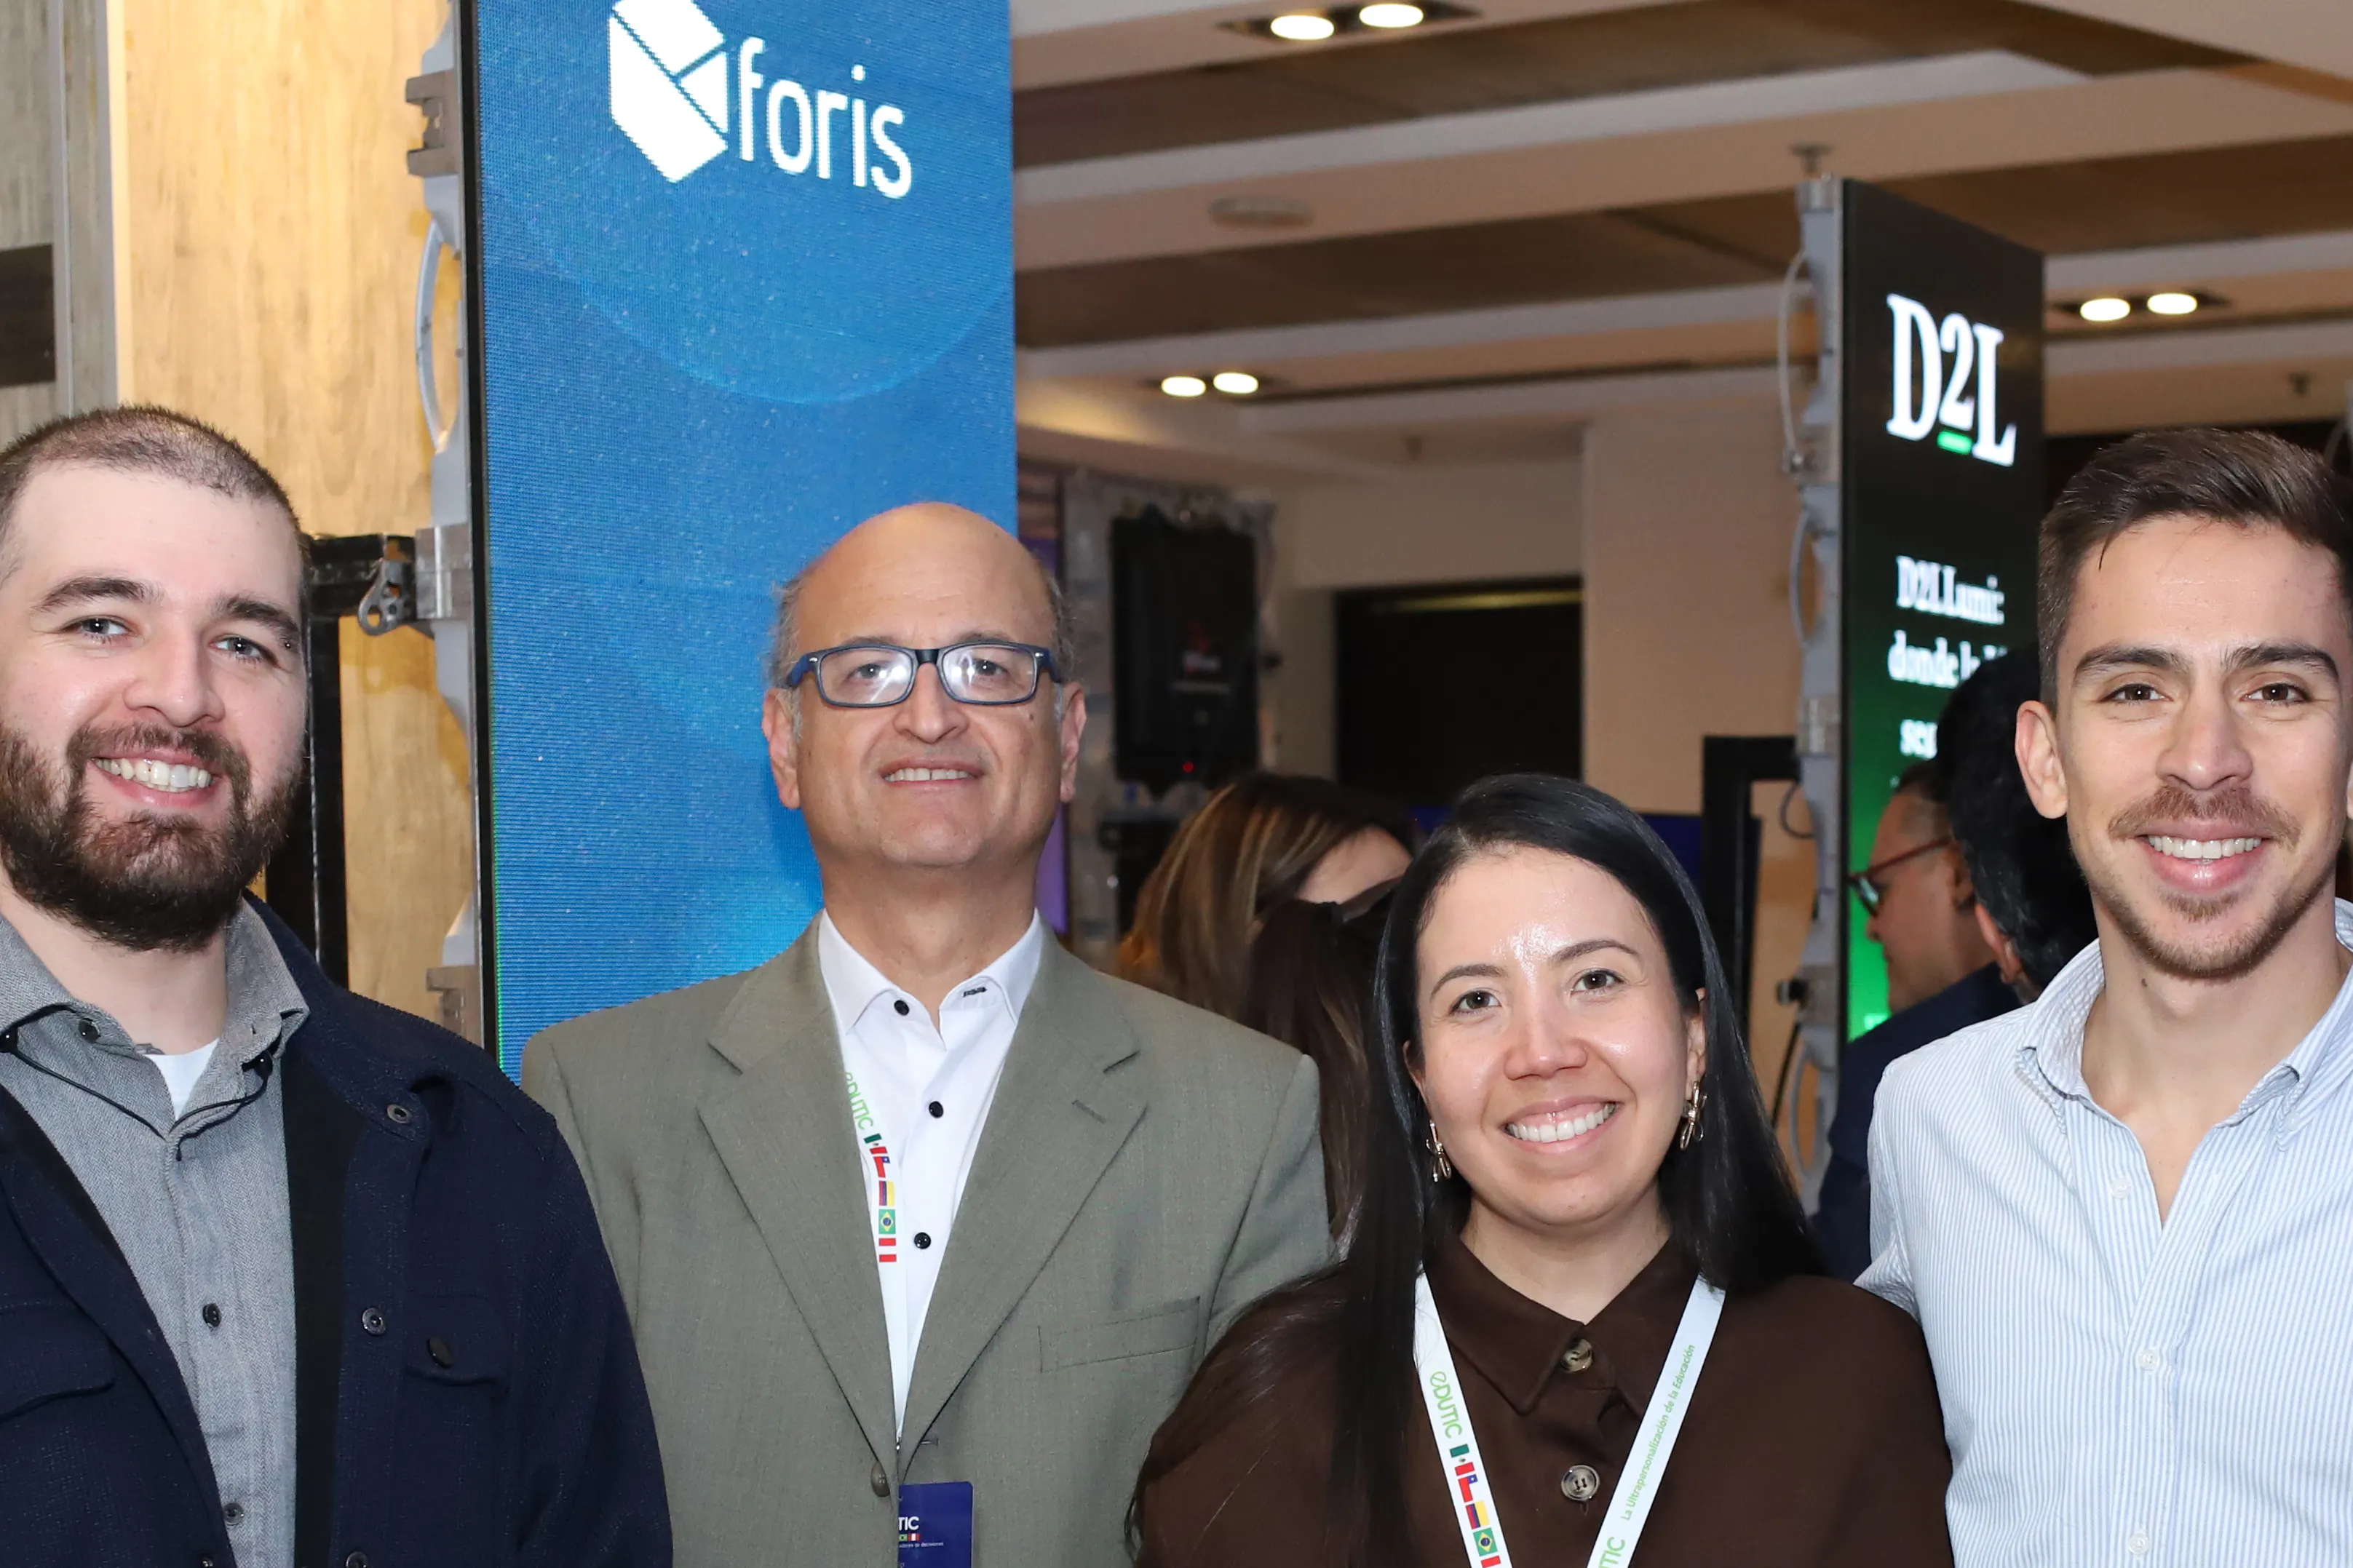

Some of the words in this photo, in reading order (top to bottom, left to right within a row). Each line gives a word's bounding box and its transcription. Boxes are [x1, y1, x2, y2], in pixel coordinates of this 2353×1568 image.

[738, 36, 913, 199] foris
[1886, 293, 2017, 466] D2L
[1887, 629, 1959, 689] donde
[1673, 1344, 1696, 1390] Educación
[1663, 1400, 1675, 1413] de
[1668, 1390, 1679, 1400] la
[1626, 1414, 1670, 1508] Ultrapersonalización
[898, 1516, 920, 1531] TIC
[1621, 1509, 1633, 1521] La
[1598, 1536, 1626, 1568] TIC
